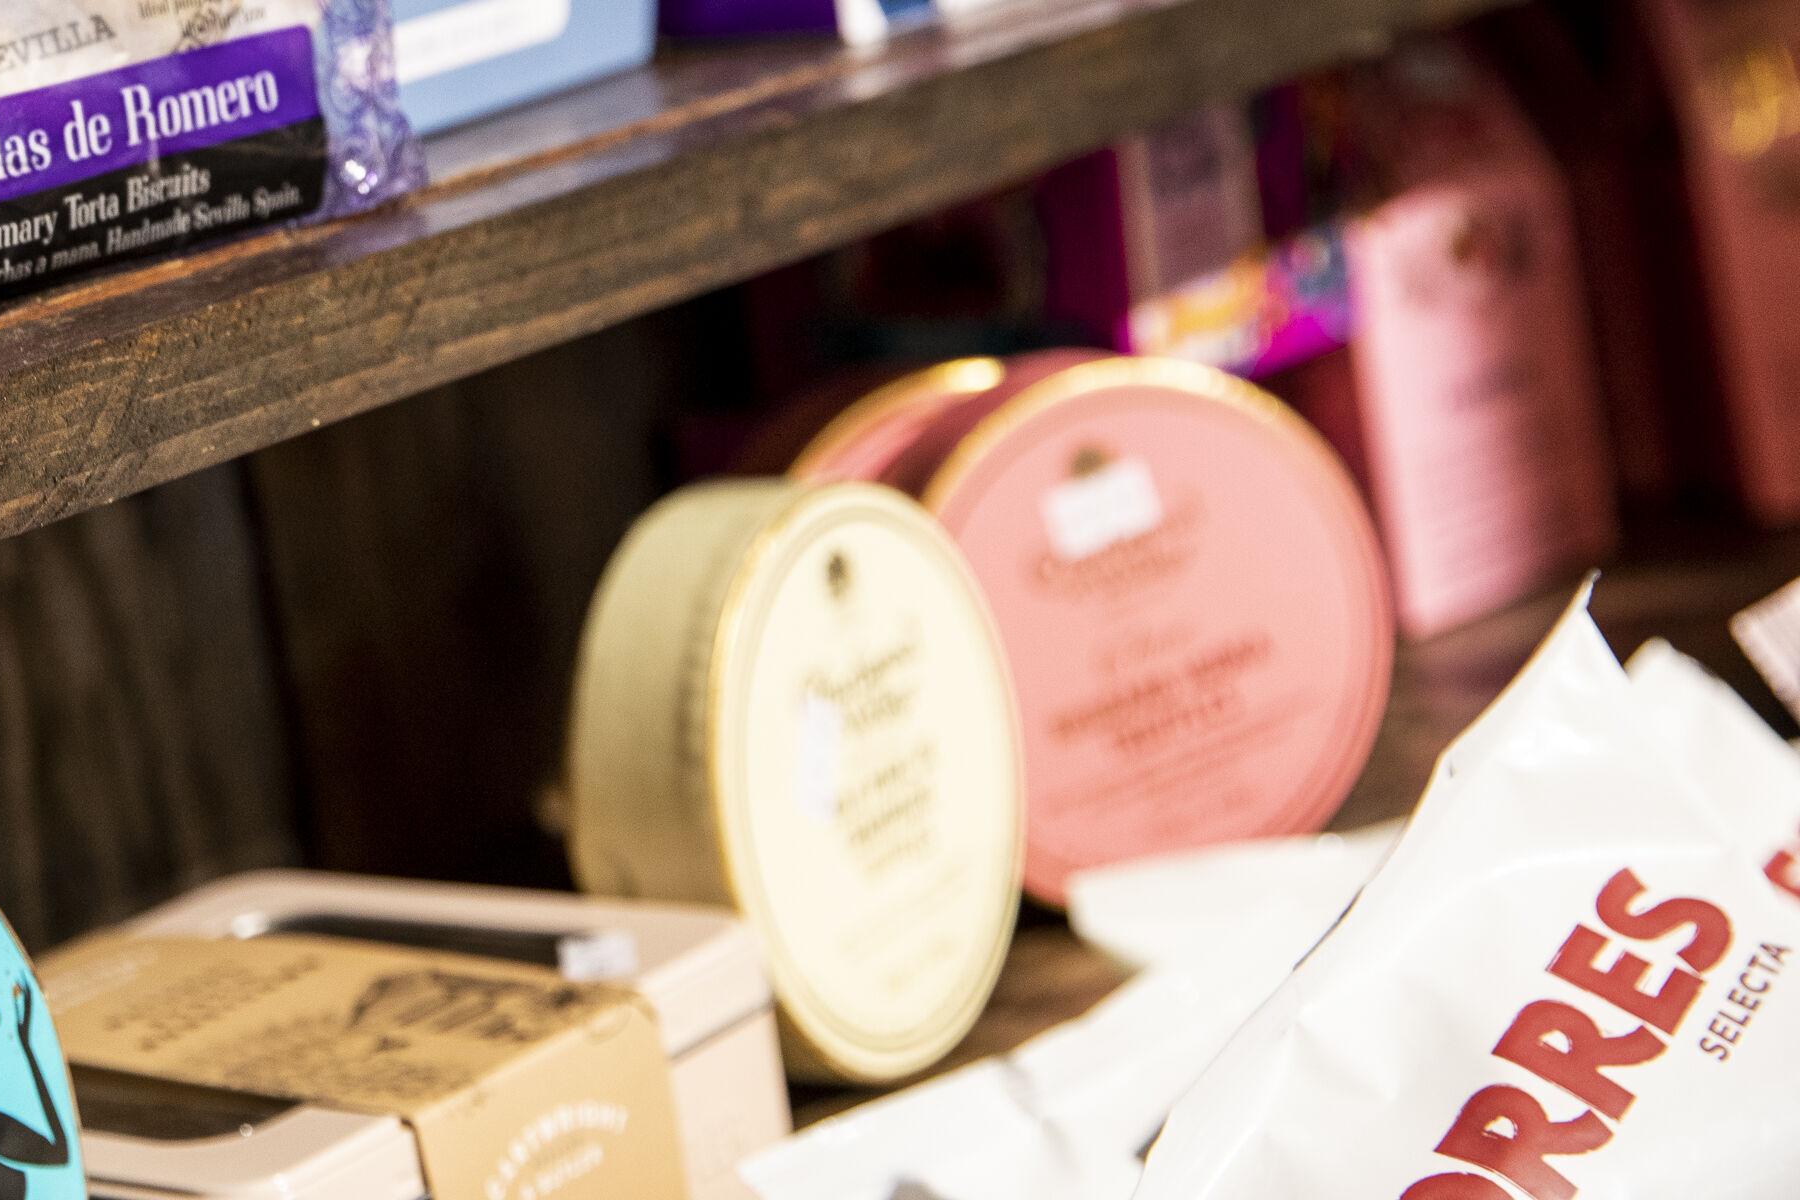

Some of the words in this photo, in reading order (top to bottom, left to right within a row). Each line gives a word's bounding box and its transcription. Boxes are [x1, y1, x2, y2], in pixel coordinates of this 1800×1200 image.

[64, 109, 113, 162] de
[121, 70, 279, 147] Romero
[34, 255, 48, 274] a
[105, 208, 192, 255] Handmade
[193, 193, 251, 230] Sevilla
[63, 192, 121, 231] Torta
[126, 162, 212, 213] Biscuits
[1399, 866, 1734, 1200] RRES
[1698, 940, 1793, 1063] SELECTA
